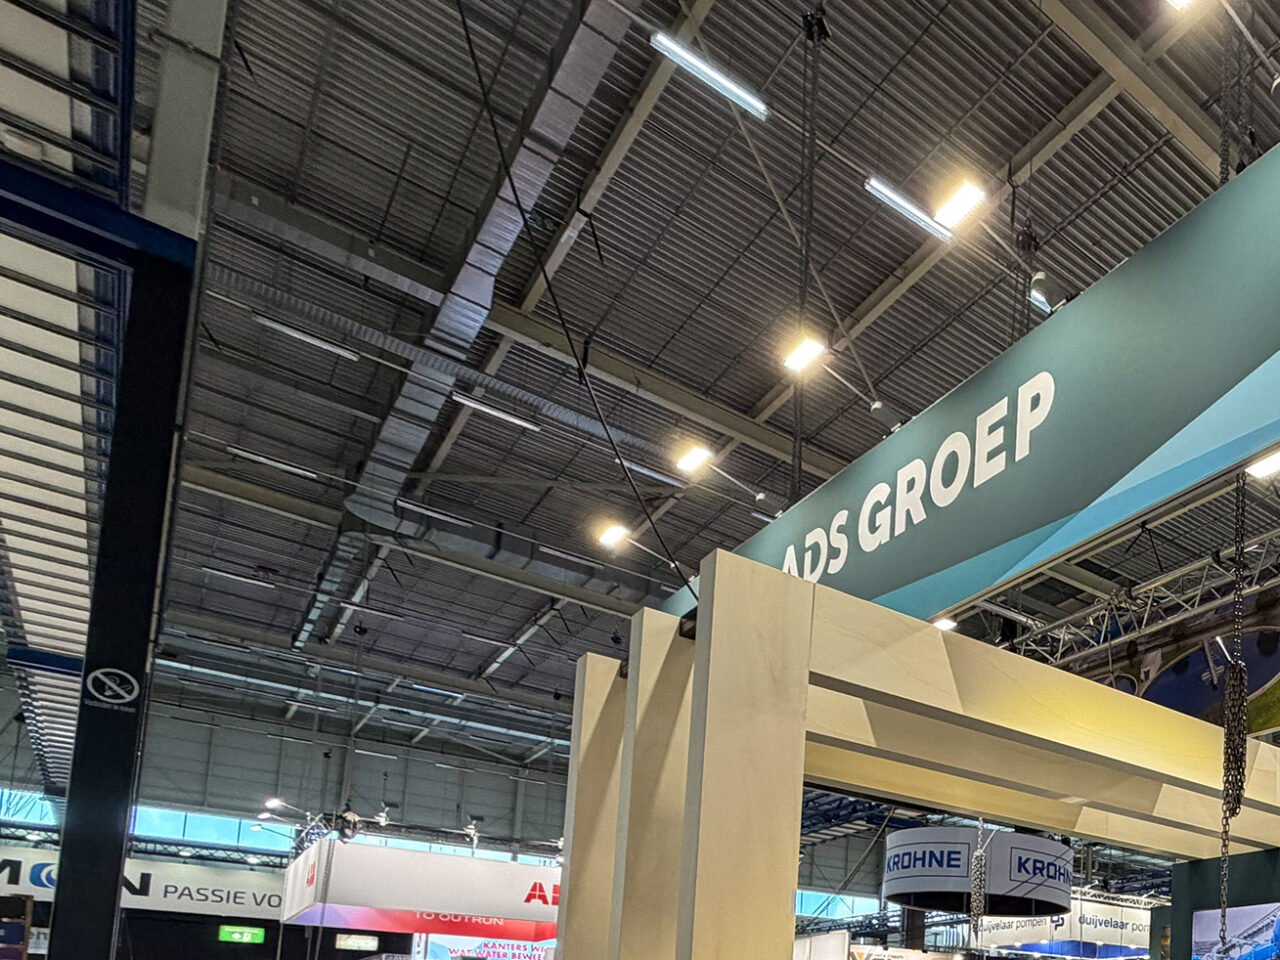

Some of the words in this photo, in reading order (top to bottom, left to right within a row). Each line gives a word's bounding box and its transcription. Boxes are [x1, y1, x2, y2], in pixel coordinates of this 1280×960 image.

[782, 510, 849, 584] ADS
[858, 371, 1055, 552] GROEP
[886, 850, 962, 875] KROHNE
[163, 884, 246, 905] PASSIE
[252, 892, 282, 908] VO
[439, 912, 504, 926] OUTRUN
[1016, 917, 1047, 931] pompen
[1078, 913, 1129, 930] duijvelaar
[511, 953, 545, 960] BEWEE
